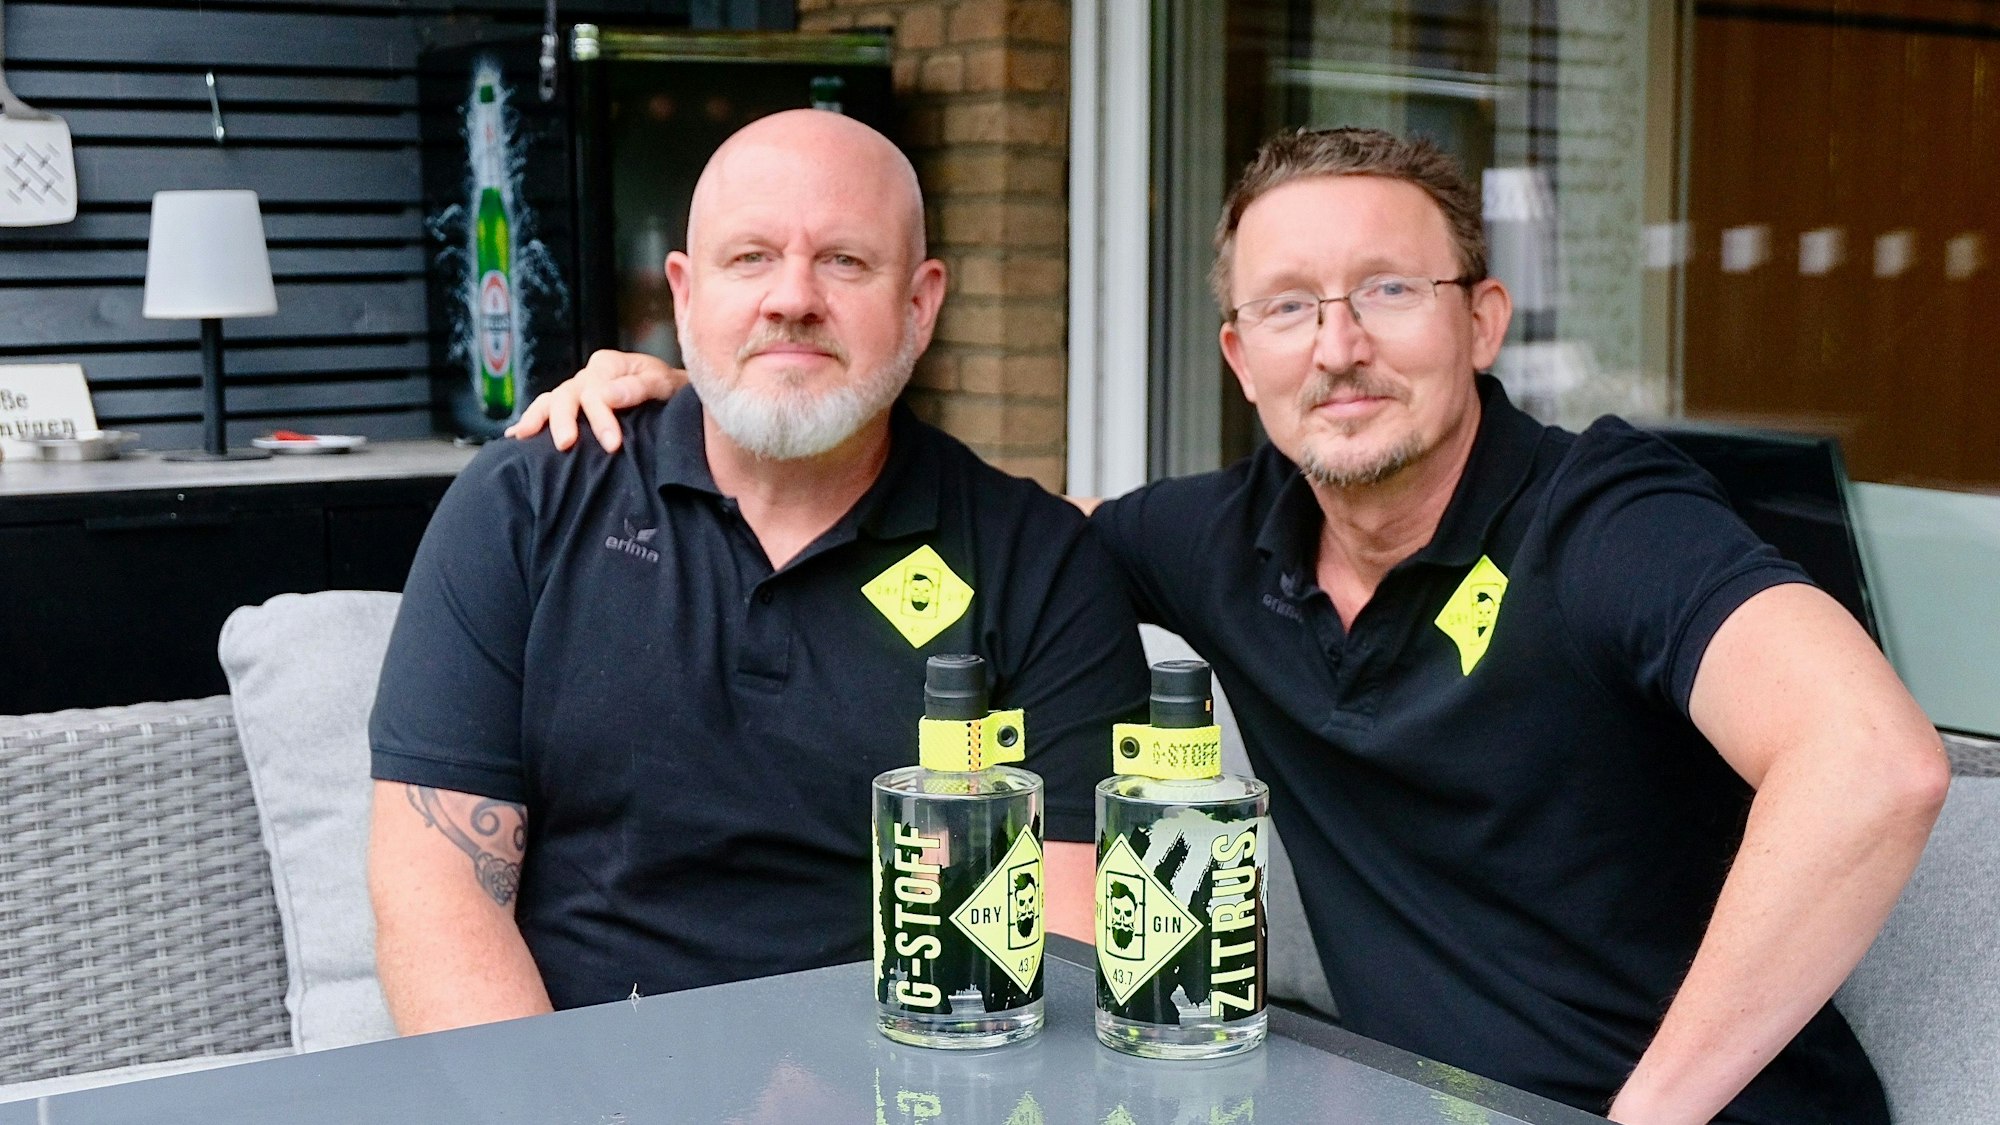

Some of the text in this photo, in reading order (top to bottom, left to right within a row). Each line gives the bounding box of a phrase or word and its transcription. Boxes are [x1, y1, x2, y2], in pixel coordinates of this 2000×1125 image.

[0, 388, 28, 411] ße
[1152, 740, 1219, 768] G-STOFF
[893, 822, 942, 1008] G-STOFF
[970, 906, 1002, 925] DRY
[1153, 915, 1182, 934] GIN
[1210, 831, 1257, 1017] ZITRUS
[1018, 955, 1035, 974] 43.7
[1112, 967, 1133, 986] 43.7
